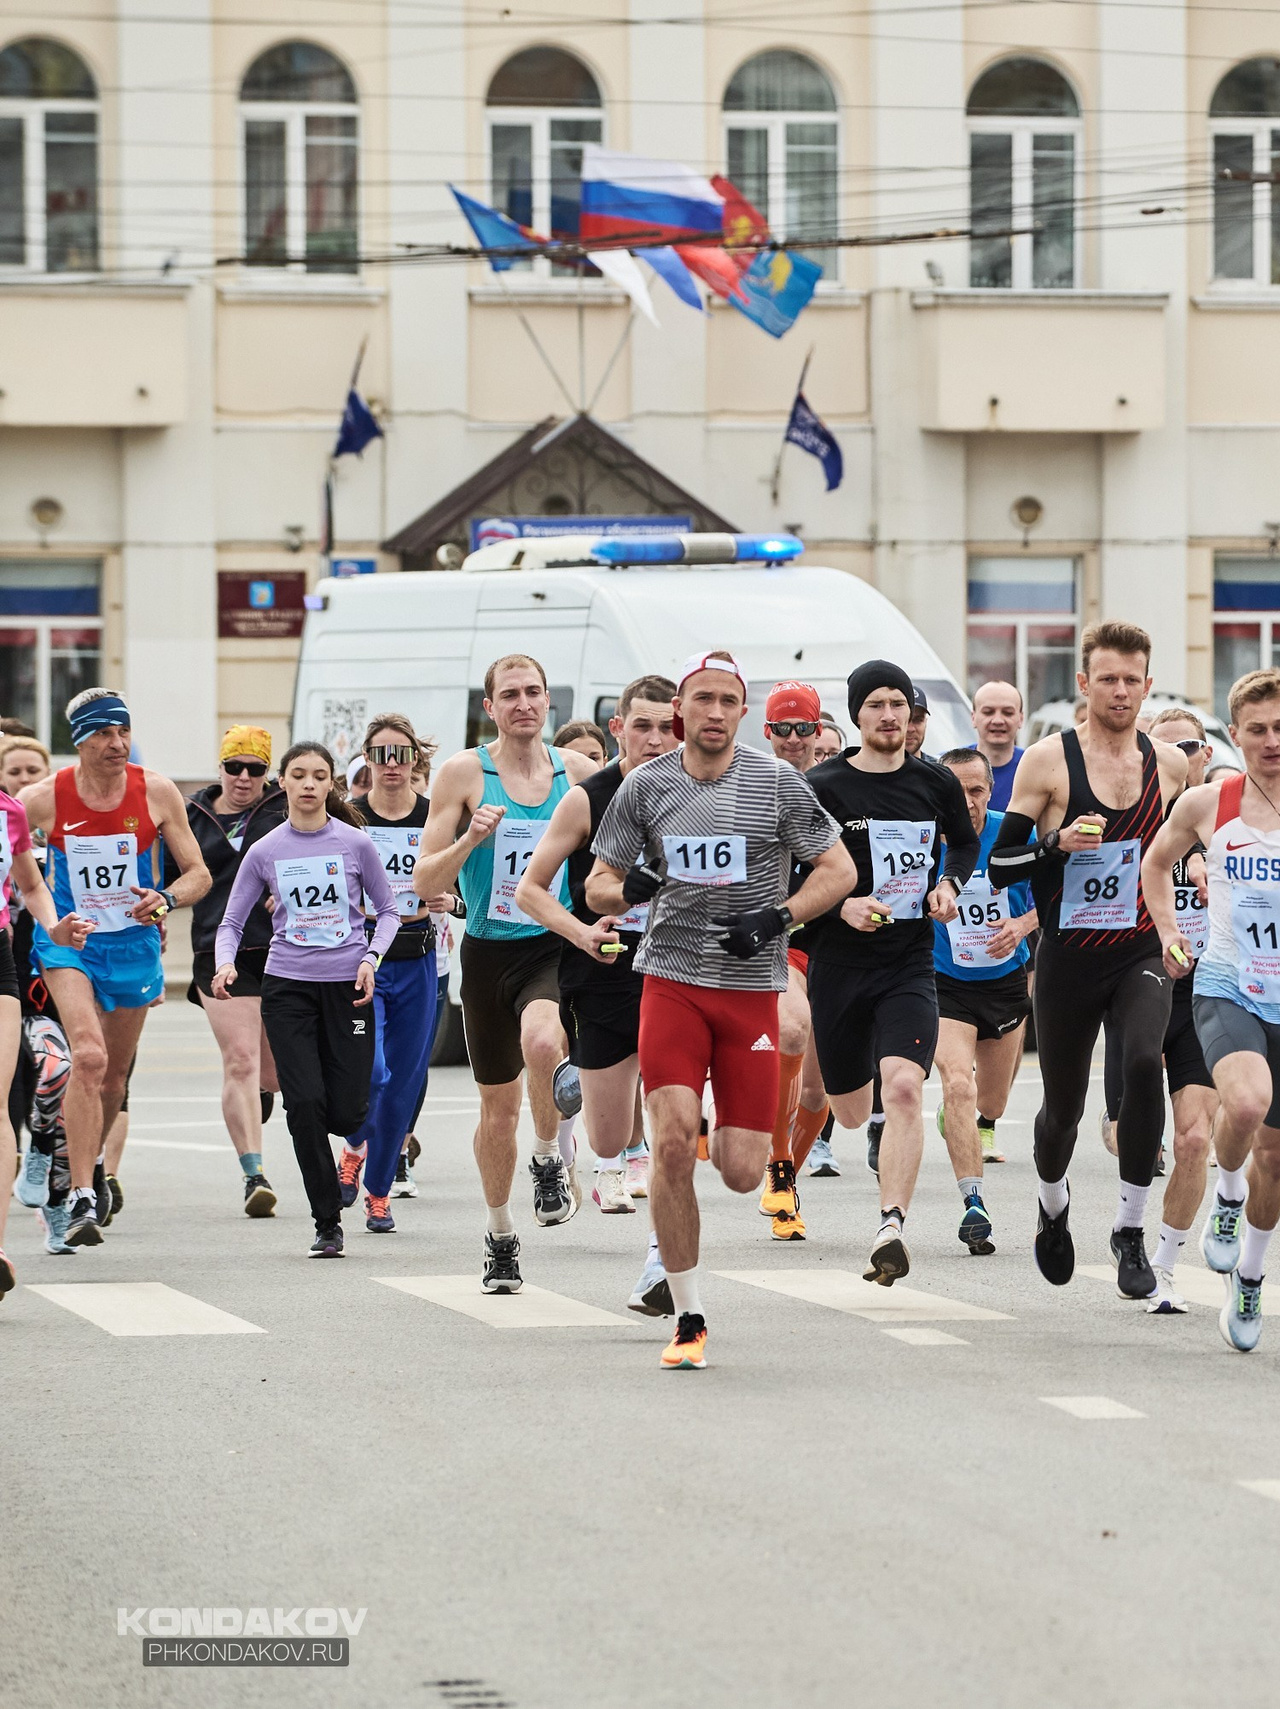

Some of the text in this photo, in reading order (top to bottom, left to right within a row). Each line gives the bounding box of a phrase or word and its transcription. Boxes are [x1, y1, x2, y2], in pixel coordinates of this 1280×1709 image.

[846, 818, 873, 831] RA
[379, 853, 416, 875] 49
[676, 841, 731, 870] 116
[79, 864, 127, 889] 187
[289, 883, 339, 908] 124
[1084, 876, 1119, 902] 98
[958, 902, 1001, 926] 195
[1071, 910, 1102, 919] КРАСНЫЙ
